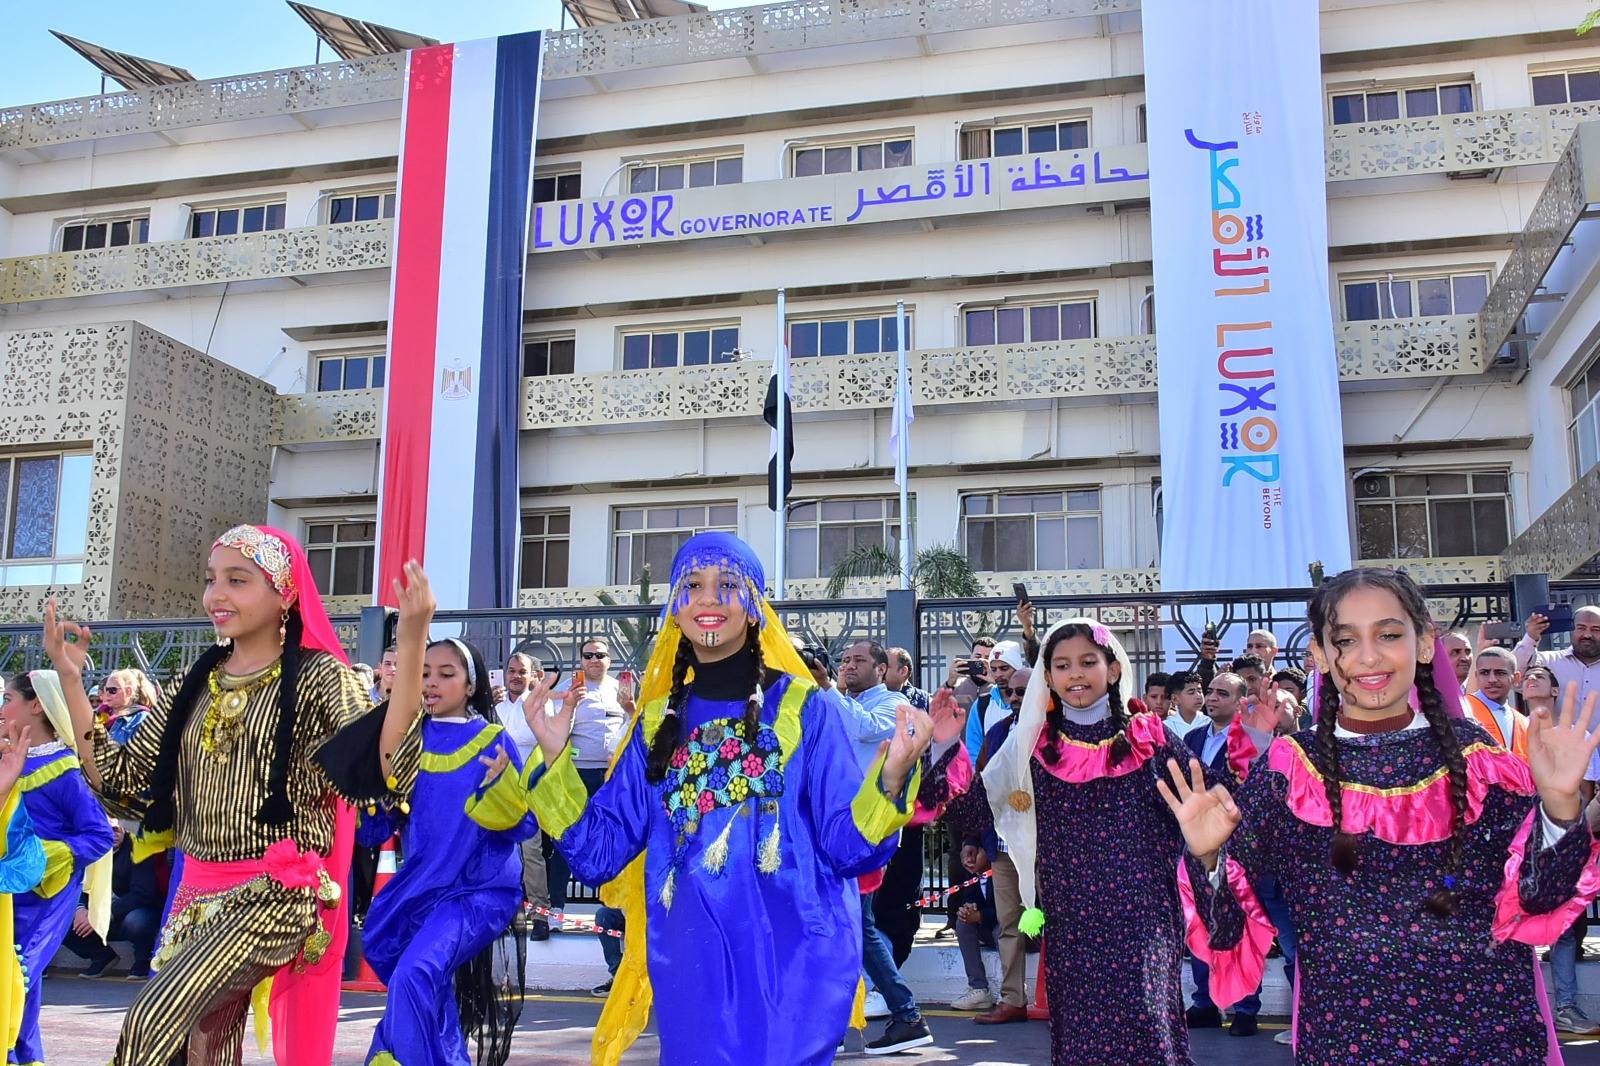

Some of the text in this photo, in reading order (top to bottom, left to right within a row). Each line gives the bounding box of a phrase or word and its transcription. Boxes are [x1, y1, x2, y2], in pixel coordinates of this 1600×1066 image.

[847, 151, 1149, 222] حافظة الأقصر
[1184, 128, 1270, 297] الأقصر
[534, 194, 833, 249] LUXOR GOVERNORATE
[1216, 320, 1280, 487] LUXOR
[1262, 487, 1272, 530] BEYOND
[1273, 486, 1282, 506] THE
